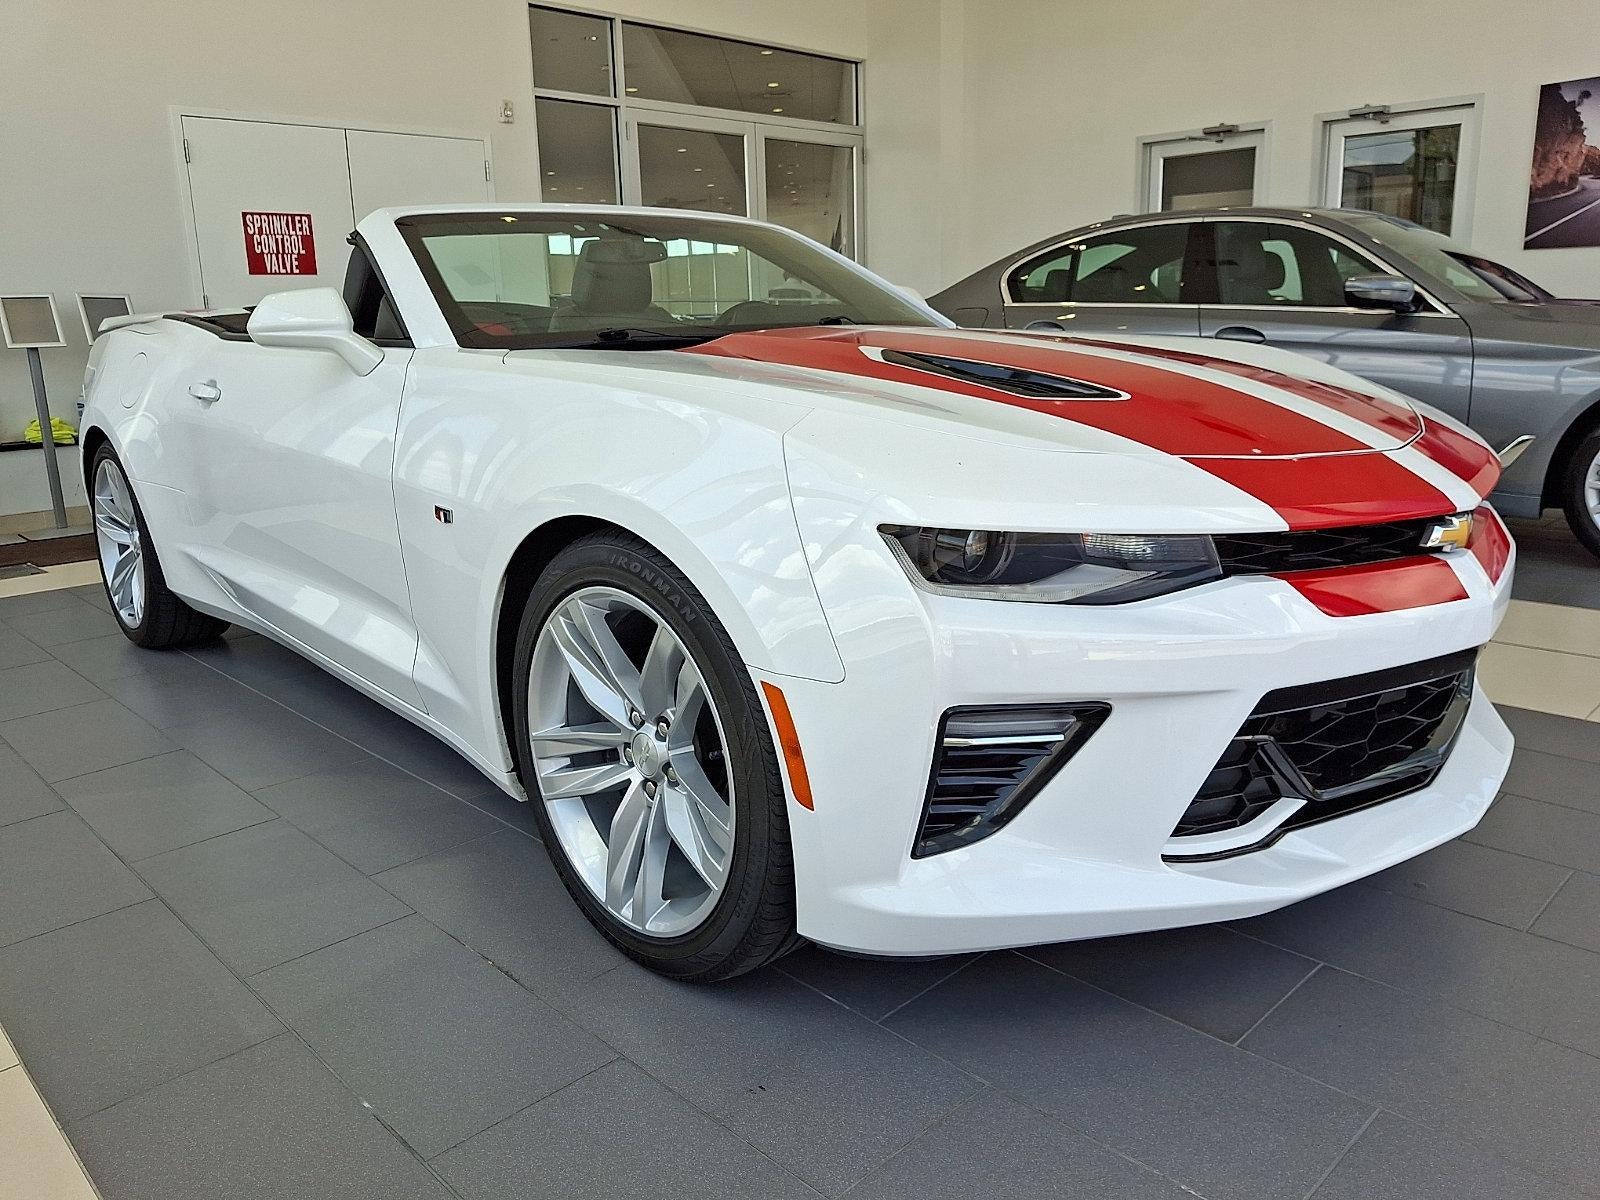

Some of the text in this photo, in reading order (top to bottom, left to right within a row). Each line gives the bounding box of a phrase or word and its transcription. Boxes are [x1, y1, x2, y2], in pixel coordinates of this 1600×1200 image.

[245, 214, 310, 235] SPRINKLER
[253, 234, 306, 254] CONTROL
[263, 253, 300, 273] VALVE
[609, 553, 697, 622] IRONMAN
